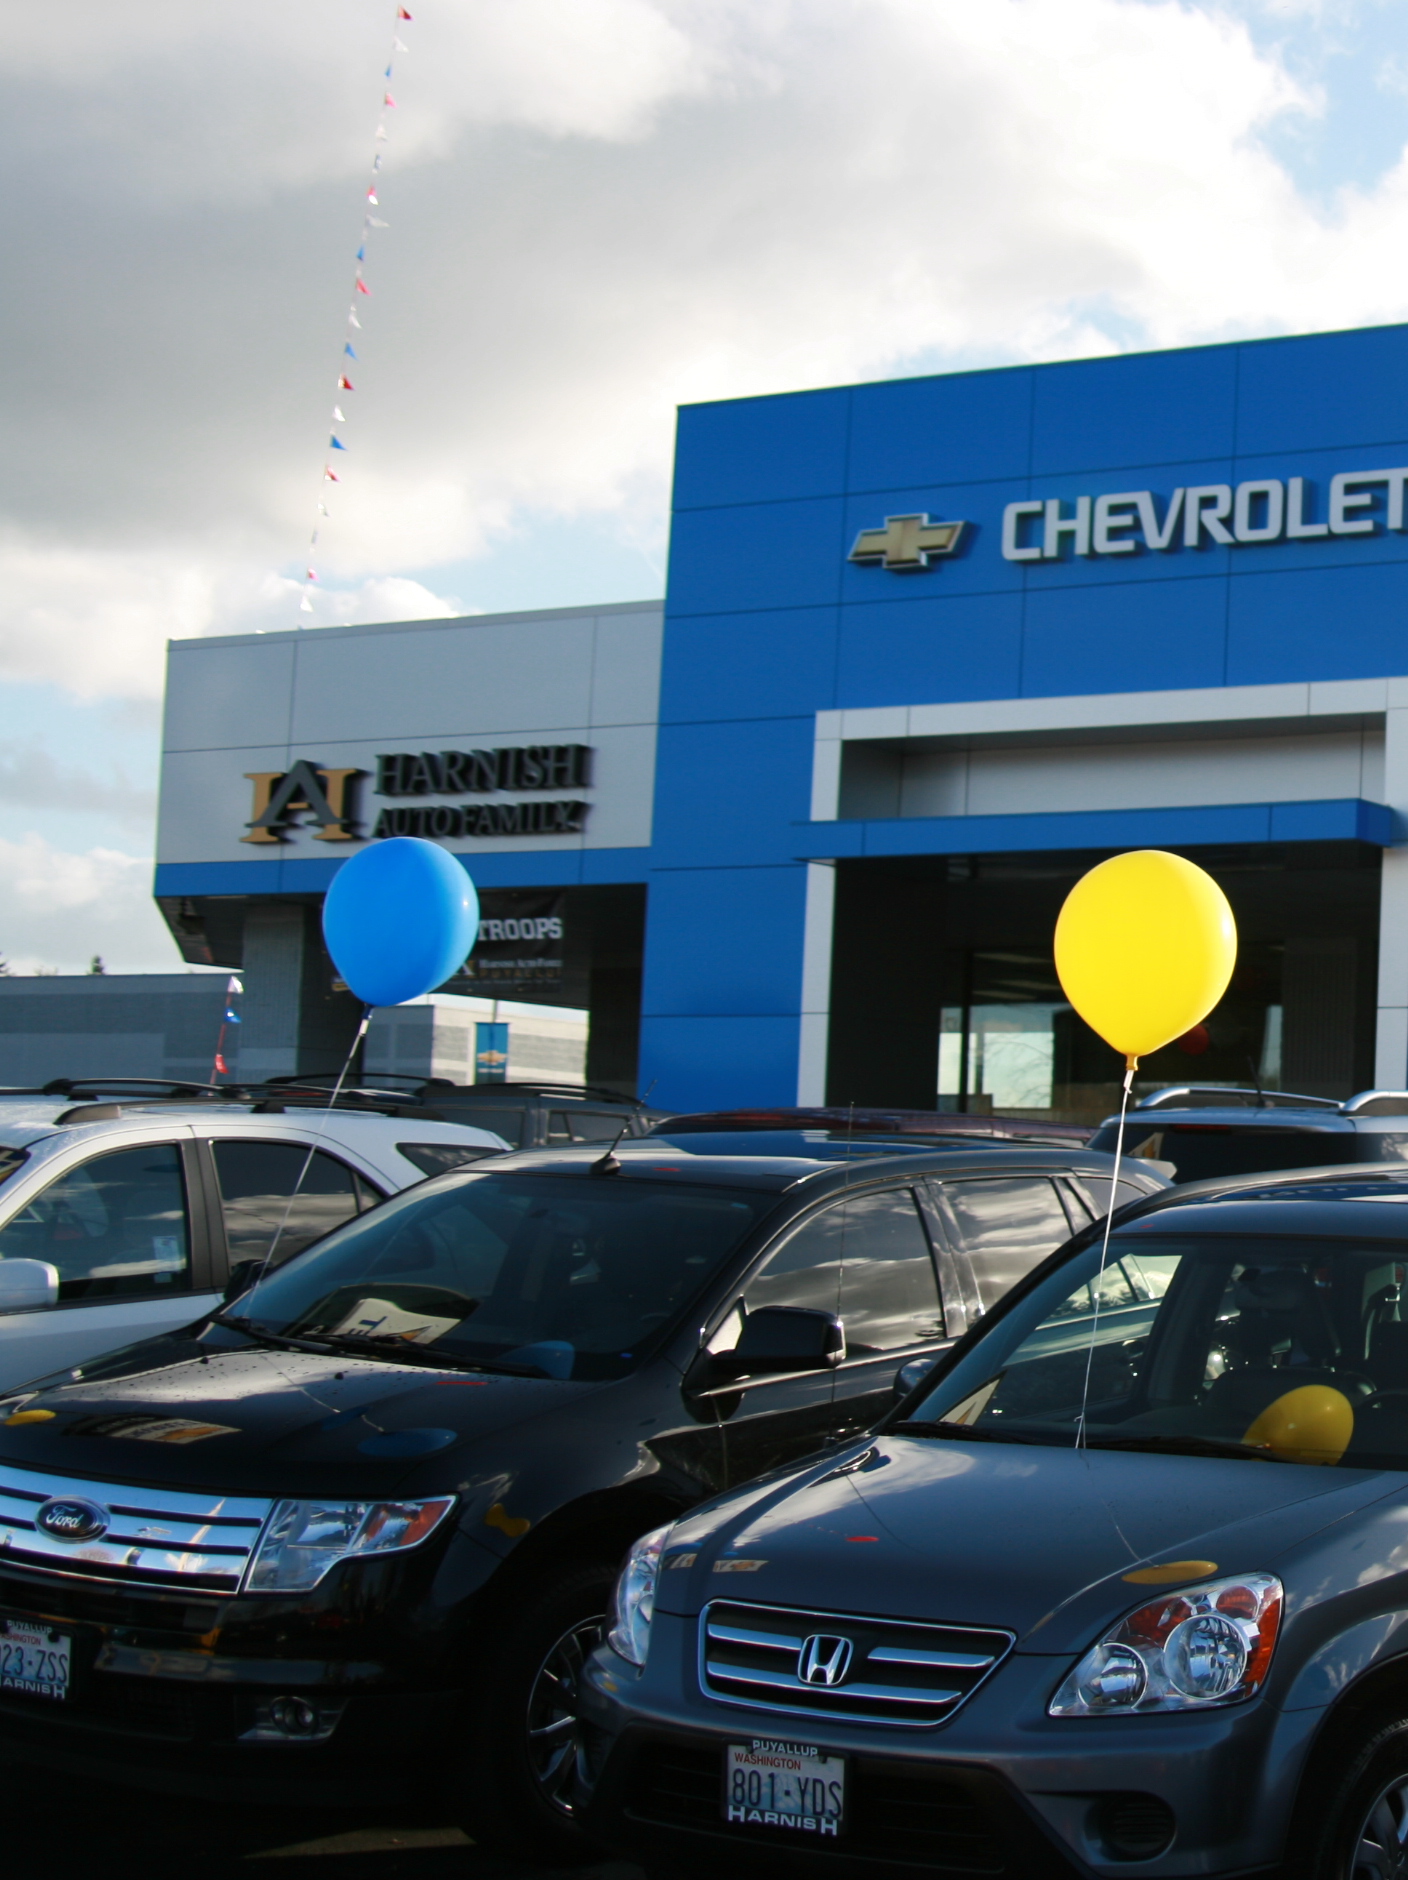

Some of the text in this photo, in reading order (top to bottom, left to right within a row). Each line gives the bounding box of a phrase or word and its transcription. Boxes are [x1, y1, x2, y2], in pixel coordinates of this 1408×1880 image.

[373, 744, 593, 796] HARNISH
[371, 800, 592, 838] AUTO FAMILY
[477, 917, 563, 941] TROOPS
[45, 1504, 84, 1528] Ford
[6, 1619, 54, 1635] PUYALLUP
[0, 1633, 42, 1646] ASHINGTON
[0, 1676, 66, 1699] ARNISH
[752, 1740, 818, 1757] PUYALLUP
[734, 1752, 802, 1771] WASHINGTON
[728, 1804, 838, 1836] HARNISH
